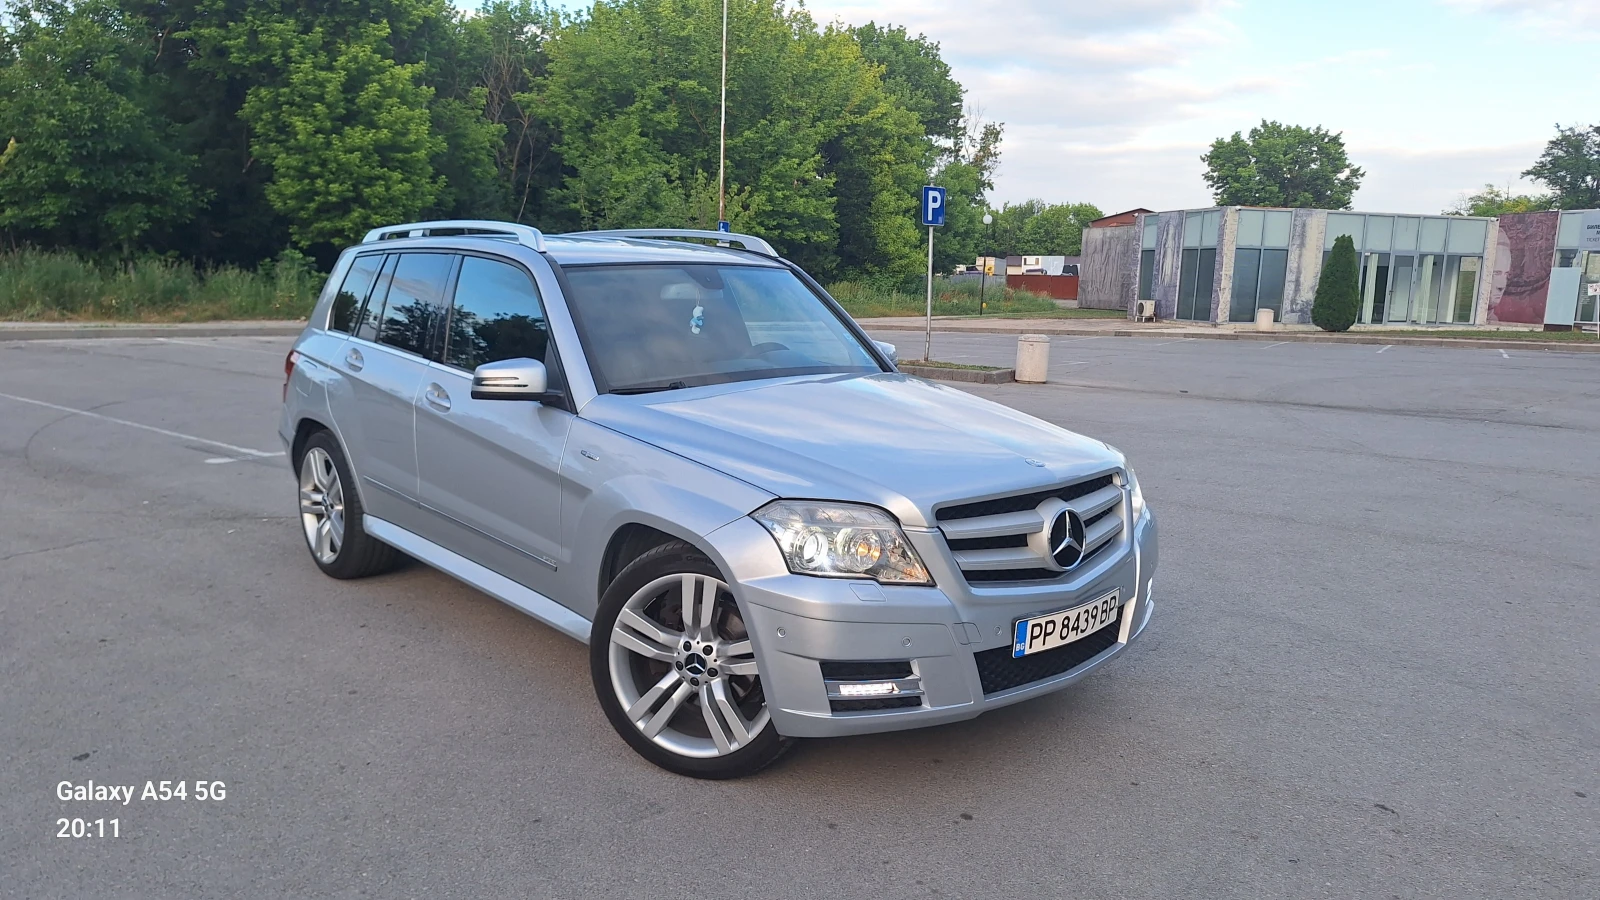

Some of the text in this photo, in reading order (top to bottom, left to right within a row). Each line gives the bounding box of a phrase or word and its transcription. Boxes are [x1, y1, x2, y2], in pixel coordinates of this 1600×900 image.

[928, 191, 941, 220] P
[1029, 596, 1116, 649] PP 8439 BP
[1016, 643, 1024, 651] BG
